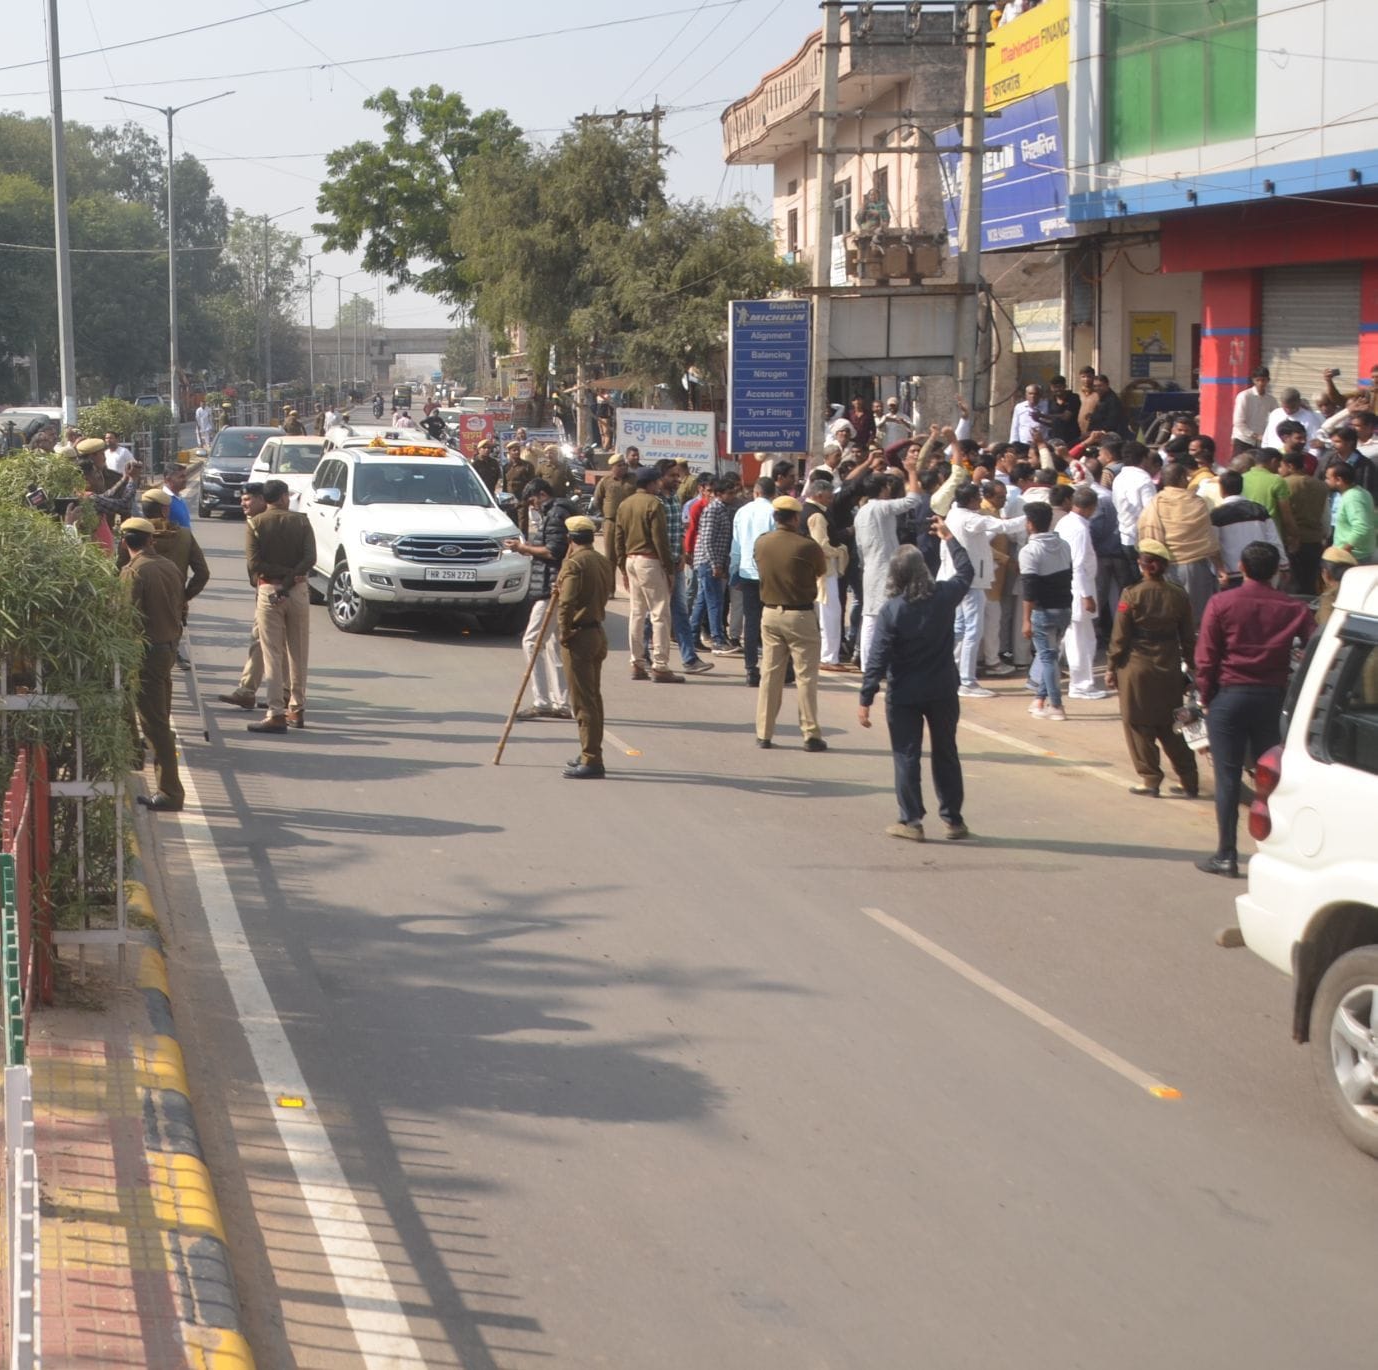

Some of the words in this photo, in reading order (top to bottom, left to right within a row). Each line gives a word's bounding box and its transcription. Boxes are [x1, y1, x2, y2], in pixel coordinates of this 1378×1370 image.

[1001, 34, 1040, 64] Mahindra
[749, 313, 806, 322] MICHELIN
[750, 331, 793, 342] Alignment
[750, 350, 792, 361] Balancing
[753, 369, 789, 380] Nitrogen
[745, 389, 795, 399] Accessories
[748, 408, 765, 418] Tyre
[767, 407, 792, 418] Fitting
[623, 419, 672, 442] हनुमान
[676, 421, 710, 437] टायर
[738, 428, 780, 438] Hanuman
[782, 428, 801, 440] Tyre
[645, 450, 709, 461] MICHELIN
[457, 571, 475, 580] 2723
